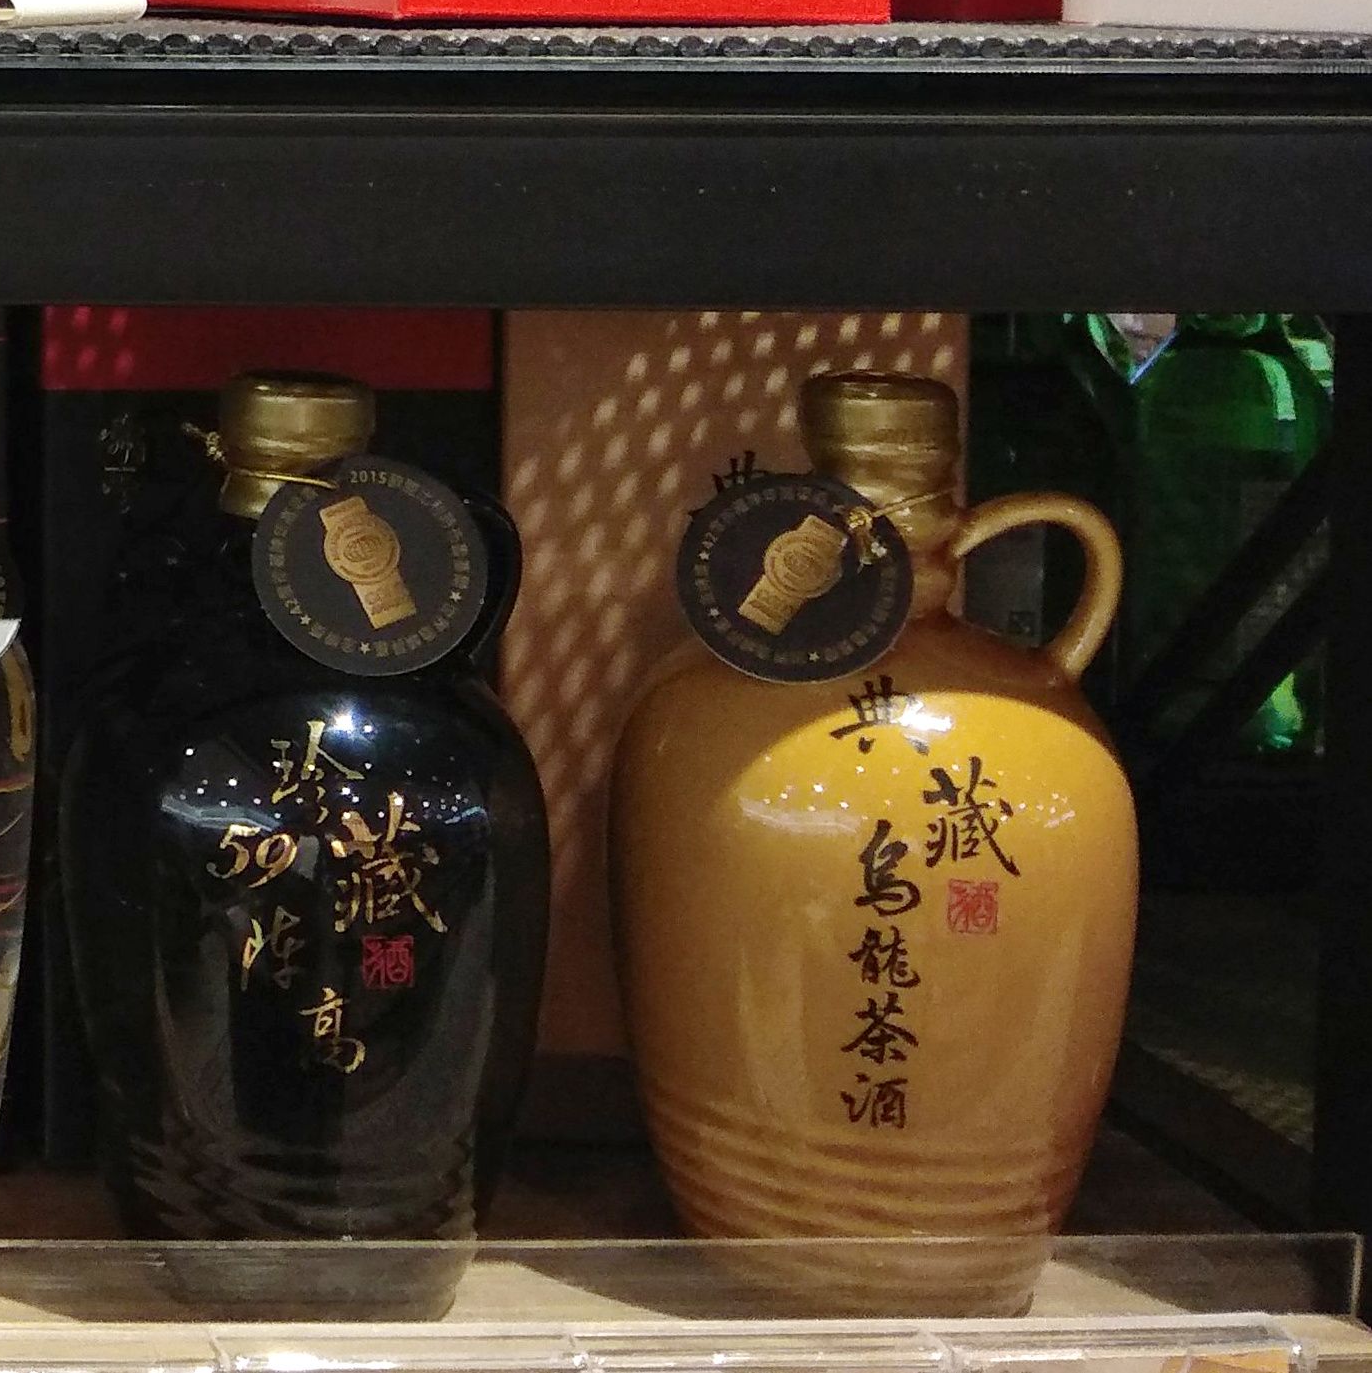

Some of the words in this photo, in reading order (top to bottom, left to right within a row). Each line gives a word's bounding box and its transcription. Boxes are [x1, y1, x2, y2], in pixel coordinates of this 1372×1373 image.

[206, 824, 298, 889] 59
[838, 819, 922, 1130] 烏龍茶酒
